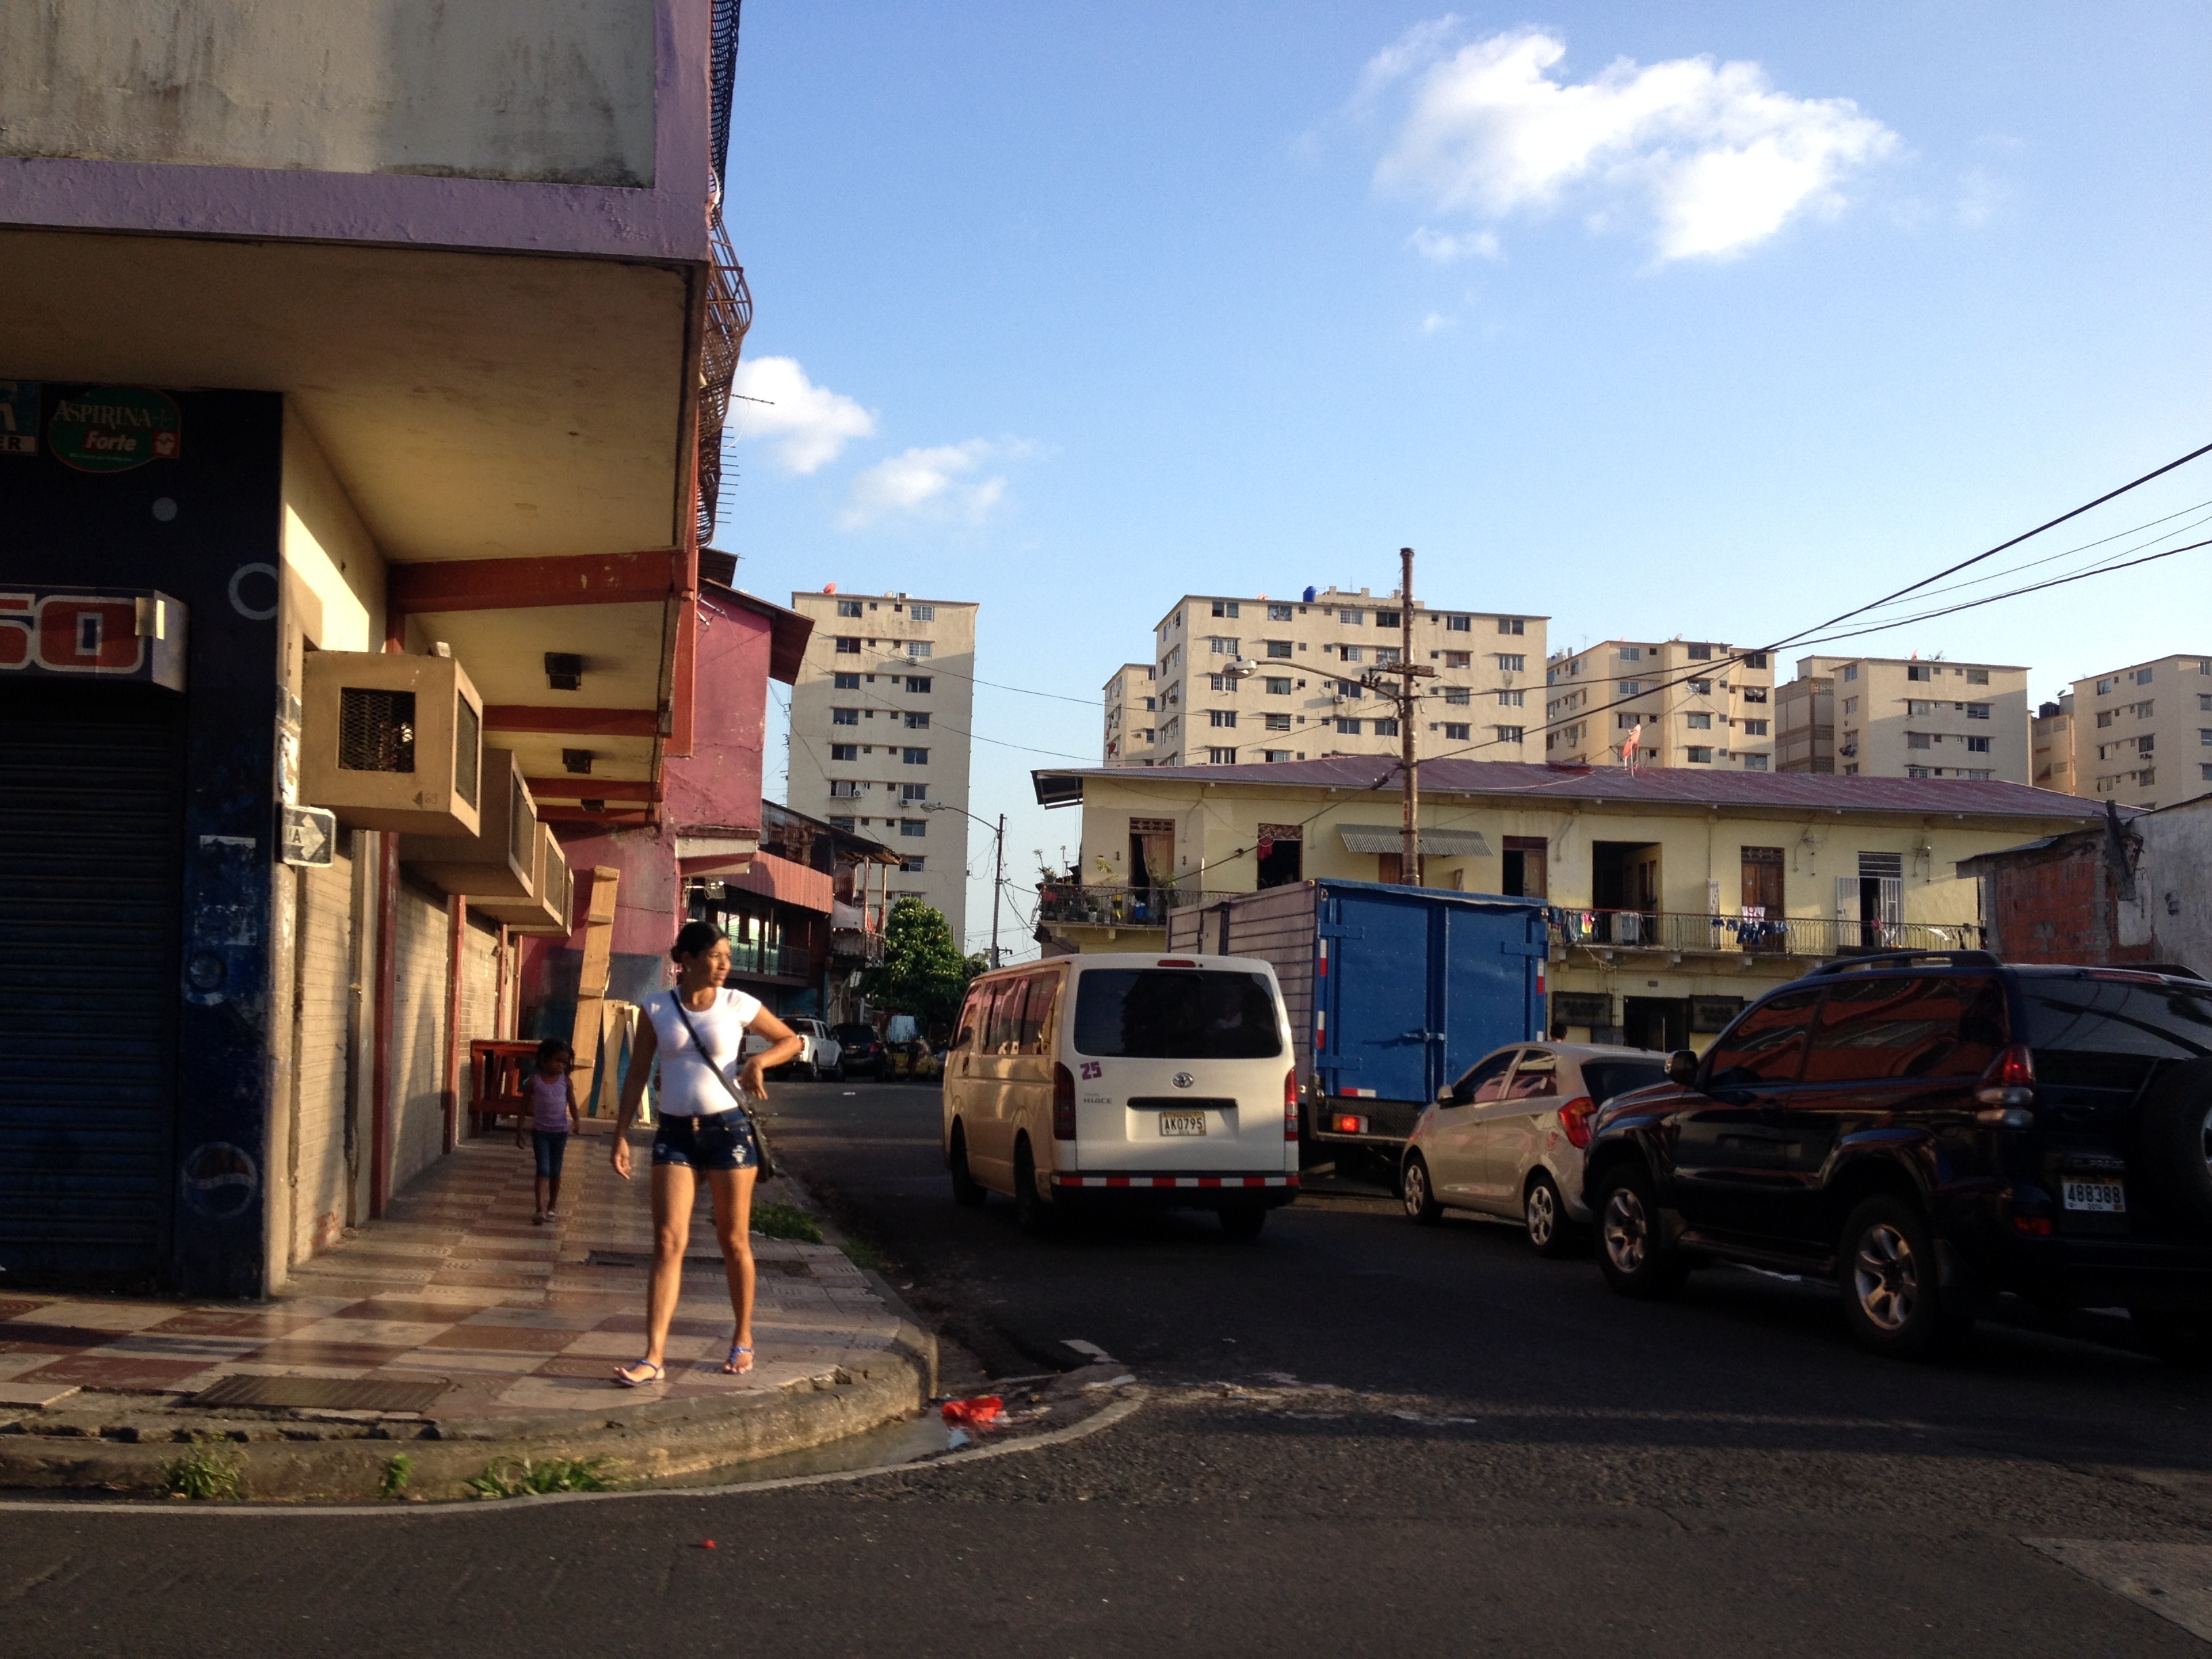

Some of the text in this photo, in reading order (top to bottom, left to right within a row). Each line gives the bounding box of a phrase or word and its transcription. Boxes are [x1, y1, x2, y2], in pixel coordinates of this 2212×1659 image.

[52, 399, 152, 429] ASPIRINA
[85, 430, 137, 451] Forte
[1080, 1061, 1102, 1080] 25
[1165, 1118, 1203, 1130] AK0795
